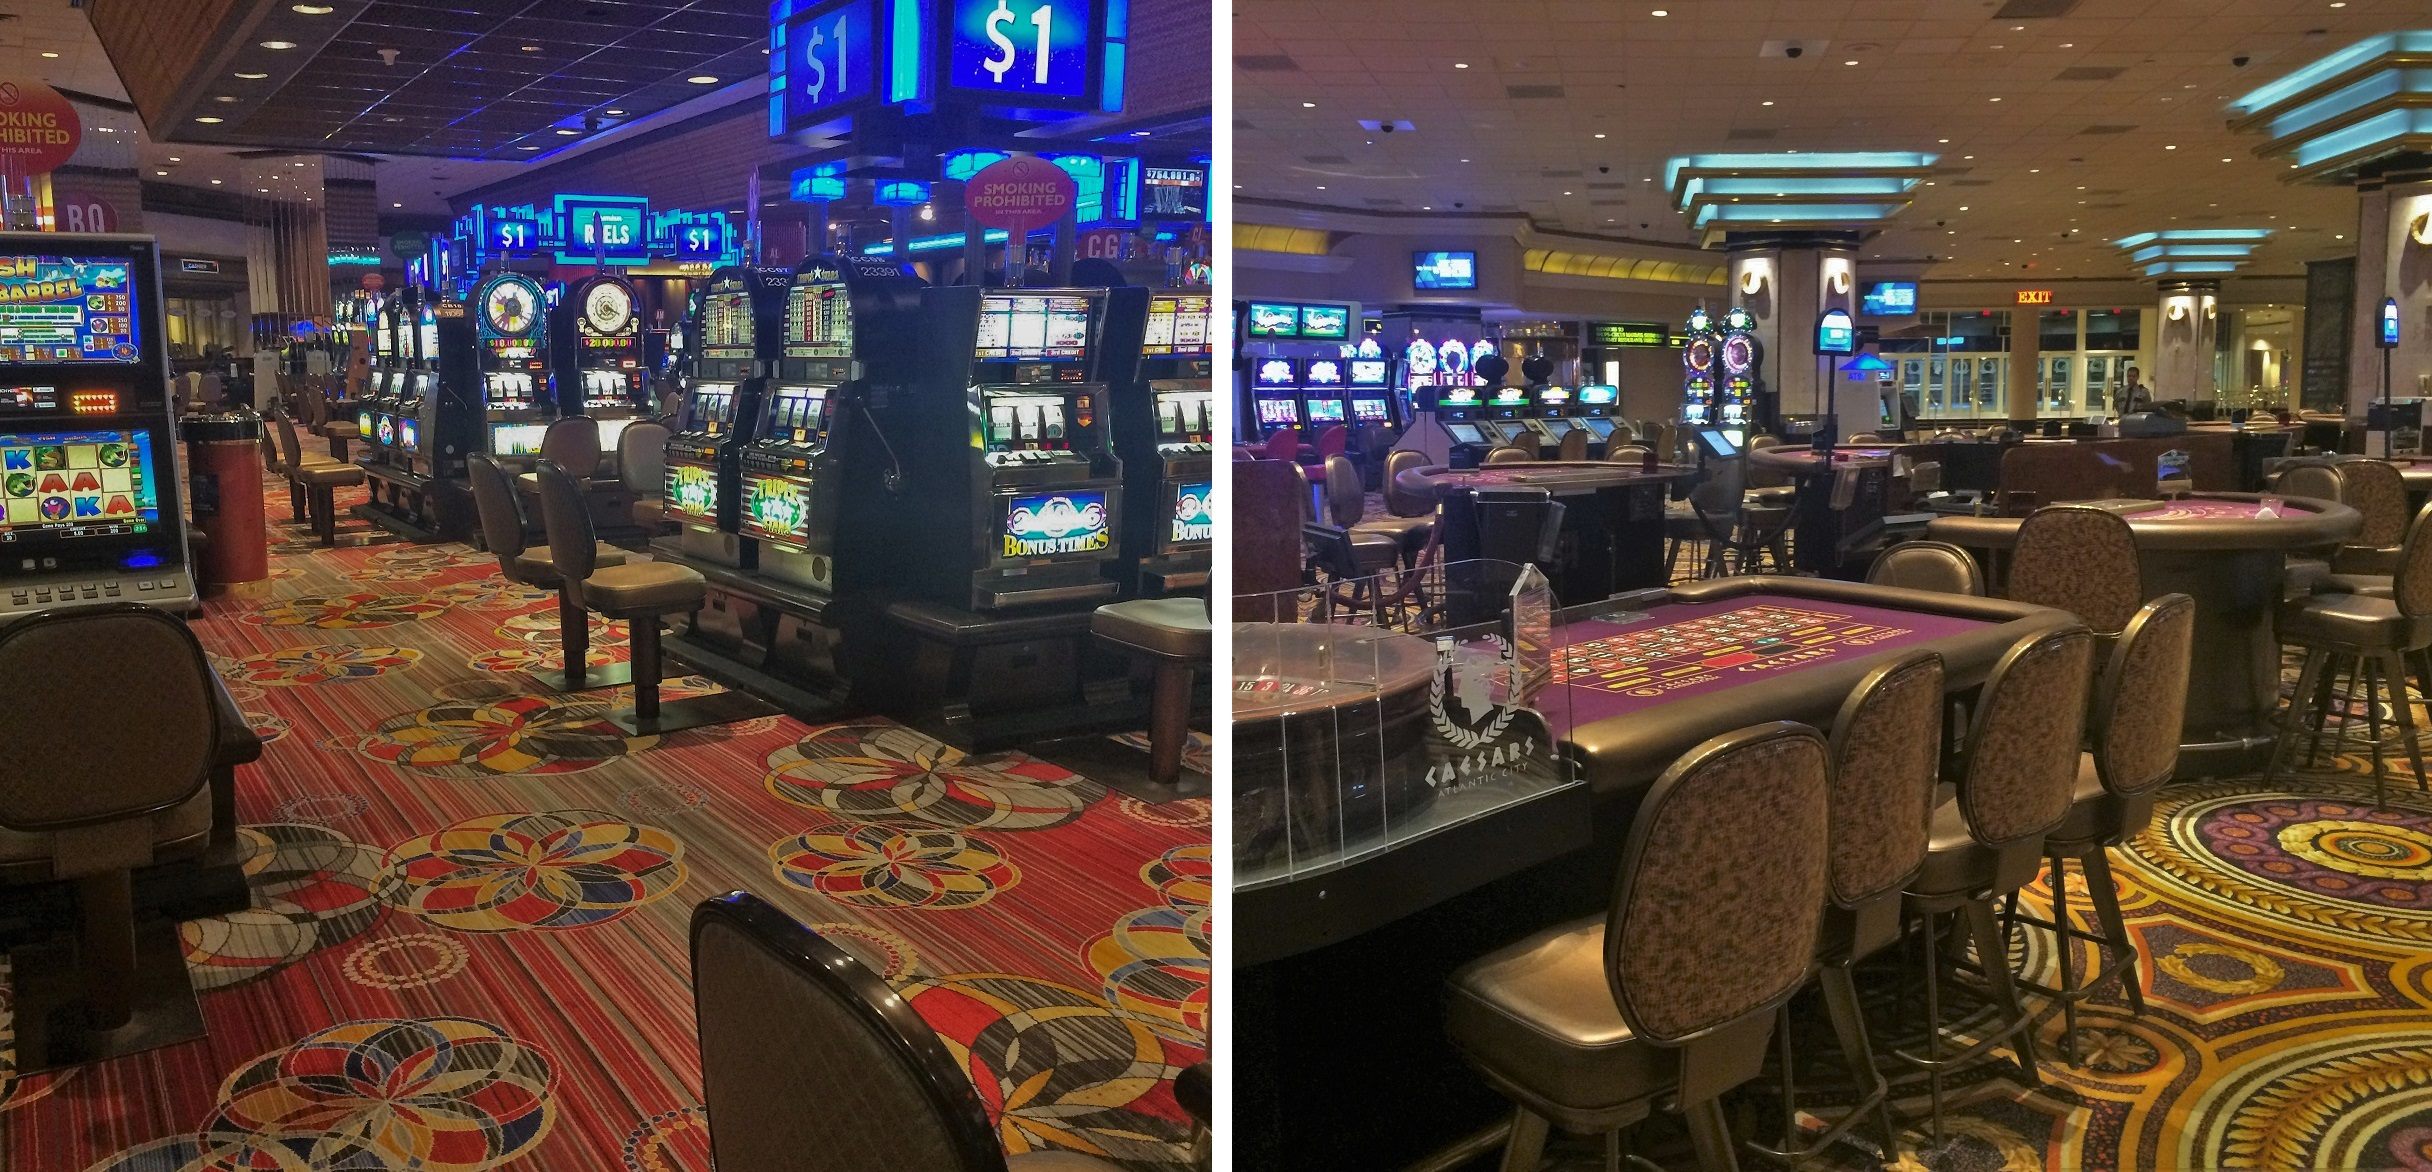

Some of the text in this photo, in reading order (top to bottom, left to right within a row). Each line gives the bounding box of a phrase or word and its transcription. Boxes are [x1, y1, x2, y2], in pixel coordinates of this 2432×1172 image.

[983, 0, 1052, 85] $1
[806, 14, 847, 104] $1
[984, 182, 1056, 195] SMOKING
[974, 194, 1065, 207] PROHIBITED
[502, 224, 524, 248] $1
[585, 224, 630, 245] RELS
[689, 228, 710, 251] $1
[1088, 235, 1119, 259] CG
[860, 267, 901, 277] 23391
[0, 279, 83, 303] BARREL
[2017, 291, 2052, 303] EXIT
[4, 449, 33, 470] K
[39, 472, 101, 494] A A
[74, 495, 135, 517] K A
[1239, 681, 1256, 691] 15
[1261, 681, 1273, 691] 3
[1424, 736, 1535, 788] CAESARS
[1437, 762, 1529, 799] ATLANTIC CITY
